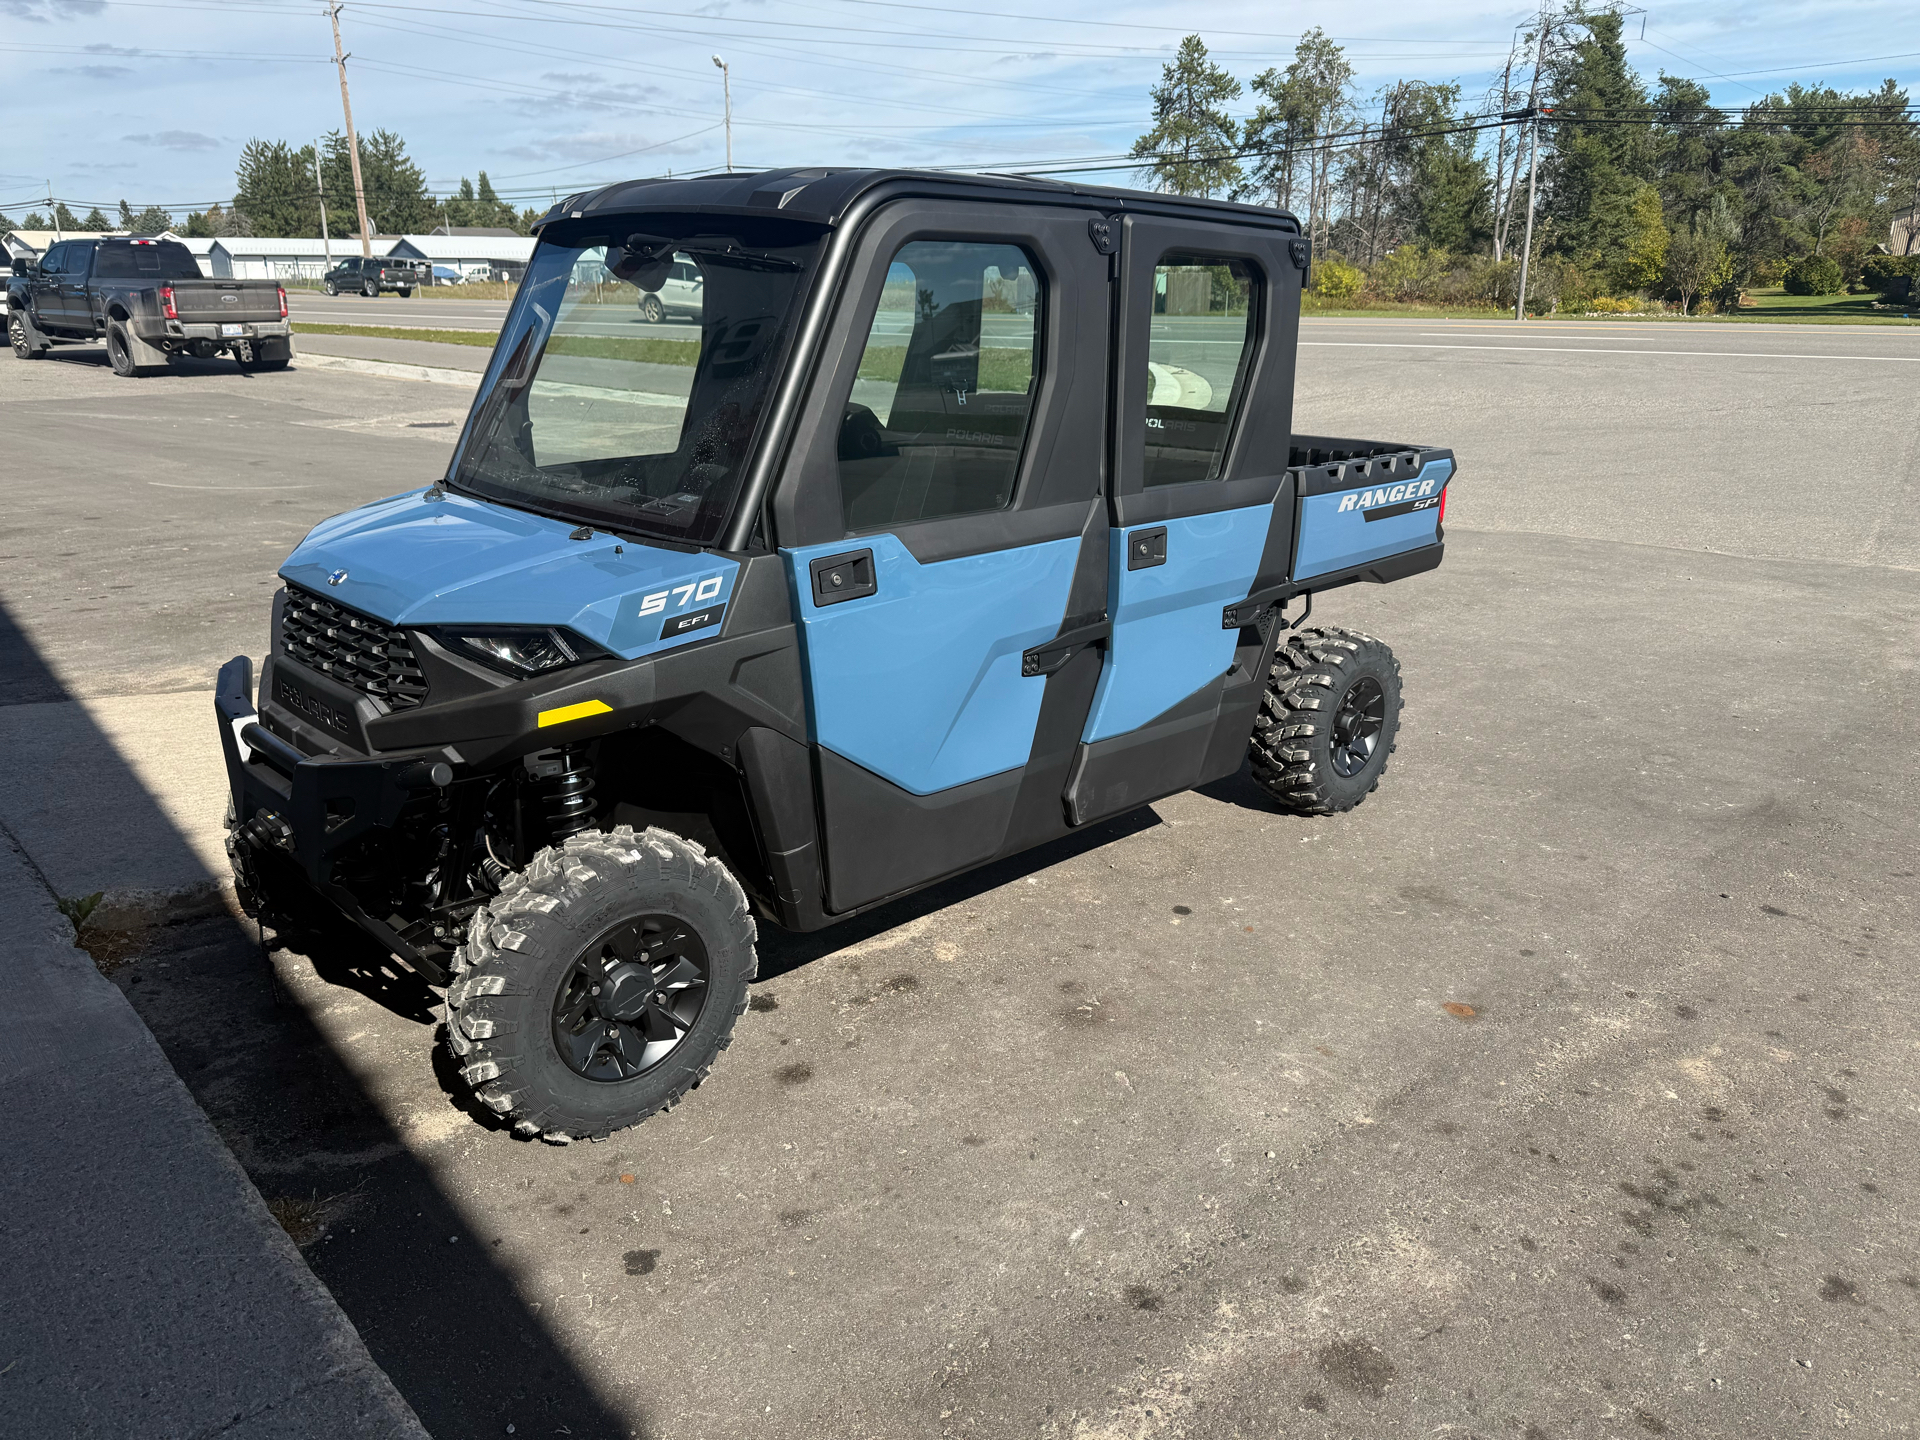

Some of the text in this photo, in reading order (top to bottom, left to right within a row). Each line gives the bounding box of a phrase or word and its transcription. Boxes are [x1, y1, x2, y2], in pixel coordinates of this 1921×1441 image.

[946, 428, 1004, 445] POLARIS
[1337, 479, 1435, 513] RANGER
[1412, 497, 1439, 511] SP
[638, 576, 723, 617] 570
[678, 614, 710, 629] EFI
[280, 679, 349, 735] POLARIS
